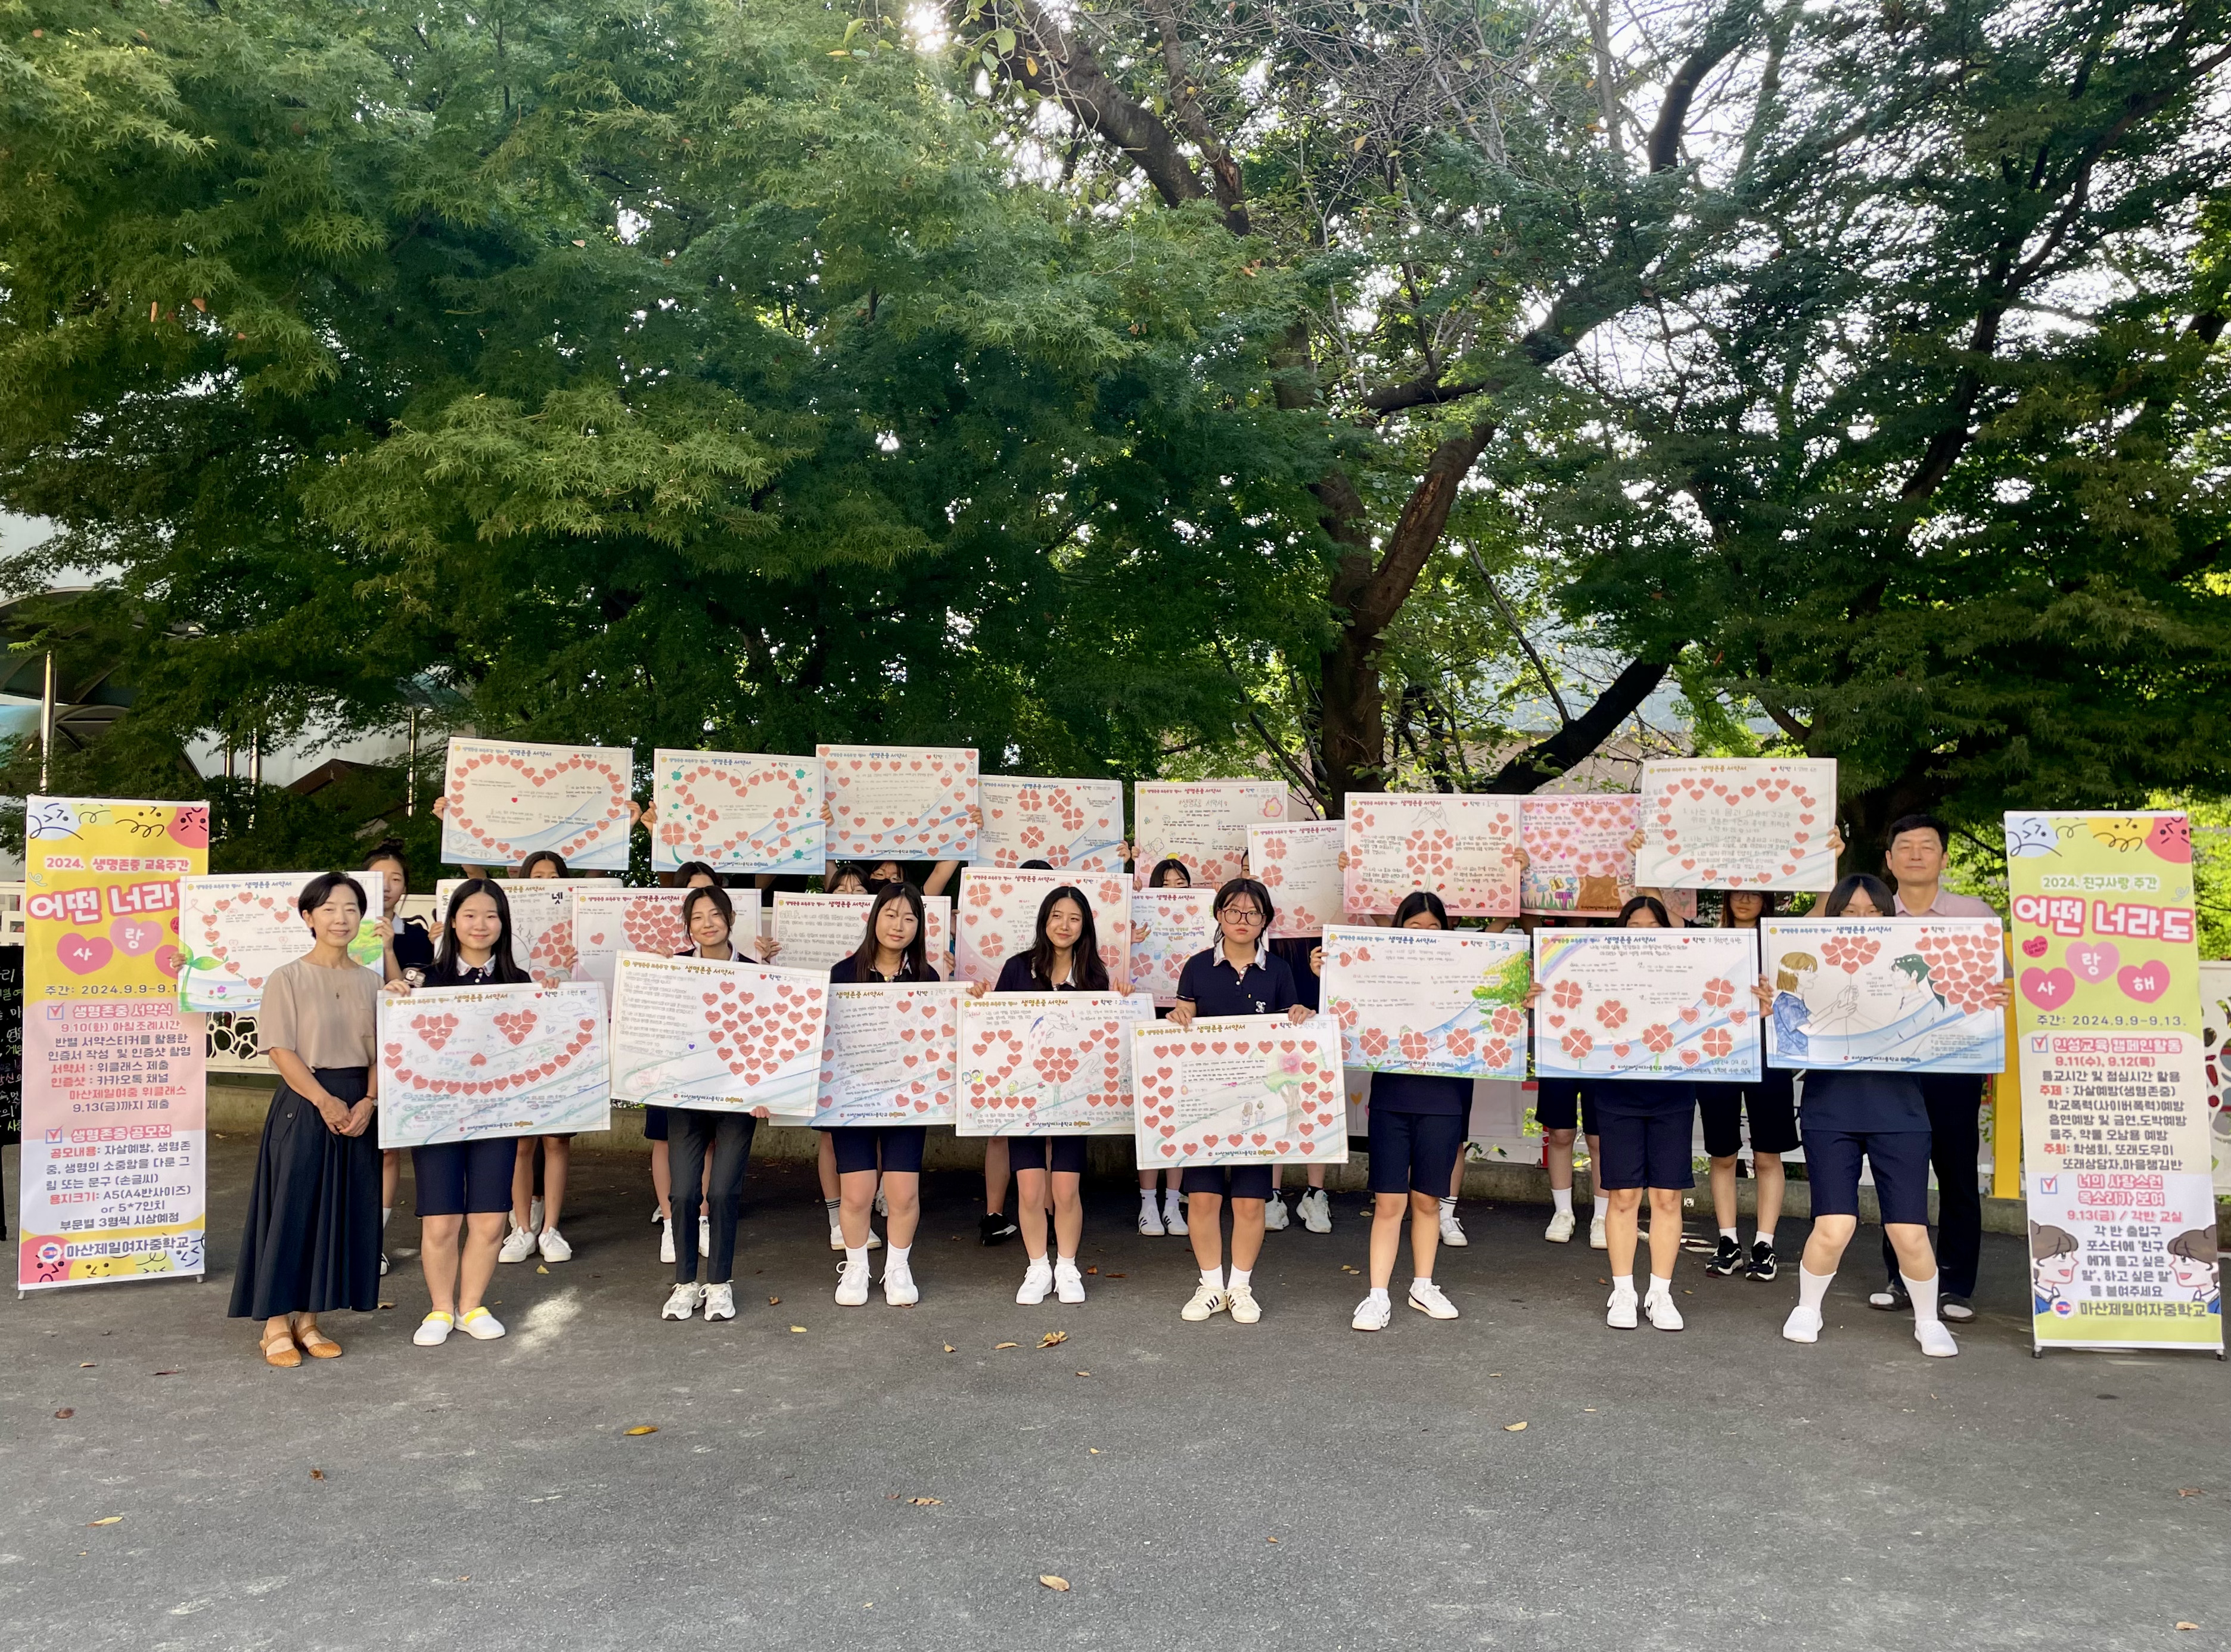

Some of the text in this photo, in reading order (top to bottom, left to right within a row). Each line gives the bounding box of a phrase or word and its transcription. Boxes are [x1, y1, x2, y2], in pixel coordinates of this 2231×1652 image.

[92, 858, 140, 870] 생명존중
[145, 859, 189, 871] 교육주간
[2134, 877, 2157, 890] 주간
[29, 883, 180, 923] 어떤 너라
[2015, 898, 2190, 940] 어떤 너라도
[73, 927, 144, 961] 사 랑
[685, 965, 735, 976] 생명존중 서약서
[2037, 953, 2155, 995] 사 랑 해
[82, 983, 178, 995] 2024.9.9-9.1
[454, 993, 483, 1002] 생명존중
[73, 1004, 172, 1018] 생명존중 서약식
[61, 1020, 181, 1033] 9.10(화) 아침조례시간
[55, 1033, 188, 1047] 반별 서약스티커를 활용한
[2053, 1039, 2109, 1052] 인성교육
[48, 1050, 82, 1061] 인증서
[86, 1049, 108, 1060] 작성
[117, 1048, 127, 1058] 및
[132, 1047, 166, 1058] 인증샷
[51, 1060, 169, 1074] 서약서 위클래스 제출
[51, 1073, 168, 1088] 인증샷 카카오톡 채널
[2093, 1072, 2102, 1082] 및
[2107, 1072, 2152, 1082] 점심시간
[70, 1086, 186, 1100] 마산제일여중 위클래스
[73, 1100, 169, 1113] 9.13(금)까지 제출
[2099, 1115, 2109, 1126] 및
[72, 1125, 172, 1142] 생명존중 공모전
[2145, 1130, 2167, 1141] 예방
[158, 1141, 191, 1152] 생명존
[2115, 1144, 2173, 1156] 또래도우미
[65, 1162, 99, 1173] 생명의
[104, 1159, 148, 1170] 소중함을
[154, 1157, 175, 1168] 다룬
[179, 1157, 190, 1166] 그
[46, 1173, 159, 1191] 림 또는 문구 (손글씨)
[2078, 1175, 2163, 1189] 너의 사랑스런
[104, 1186, 191, 1200] A5(A4반사이즈)
[2078, 1191, 2165, 1206] 목소리가 보여
[101, 1205, 114, 1213] or
[60, 1213, 179, 1231] 부문별 3명씩 시상예정
[2068, 1210, 2183, 1223] 9.13(금) 각반 교실
[2095, 1226, 2105, 1236] 각
[2111, 1226, 2122, 1236] 반
[67, 1236, 189, 1257] 마산제일여자중학교
[2087, 1240, 2133, 1252] 포스터에
[2087, 1256, 2111, 1266] 에게
[2142, 1256, 2165, 1266] 싶은
[2104, 1271, 2128, 1282] 하고
[2132, 1271, 2155, 1282] 싶은
[2081, 1302, 2205, 1317] 마산제일여자중학교
